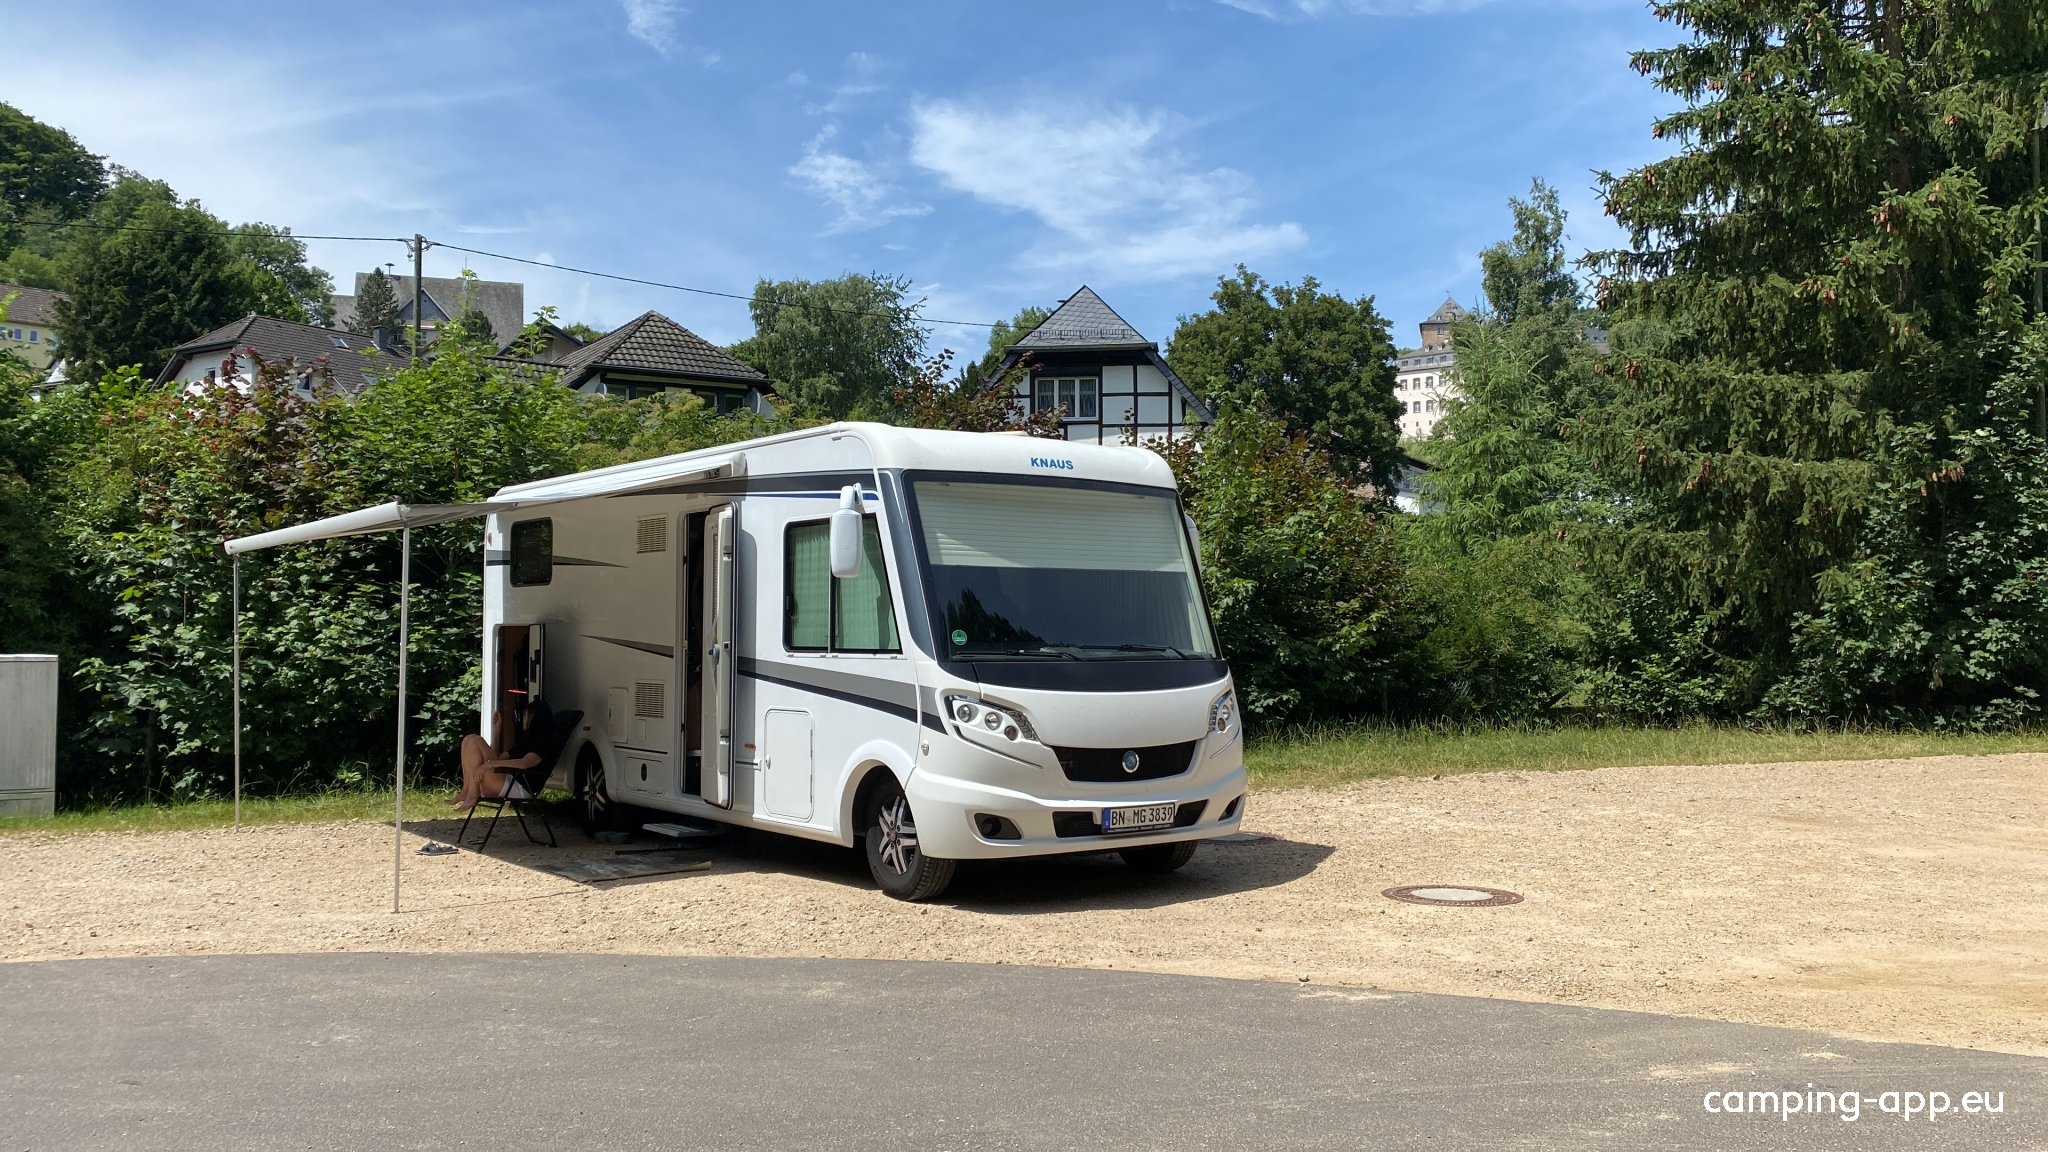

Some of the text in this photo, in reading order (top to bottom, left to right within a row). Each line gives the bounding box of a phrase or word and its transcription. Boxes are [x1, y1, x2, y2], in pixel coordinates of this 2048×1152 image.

[1030, 457, 1074, 470] KNAUS
[1111, 810, 1125, 826] BN
[1133, 808, 1147, 824] MG
[1149, 806, 1173, 823] 3839
